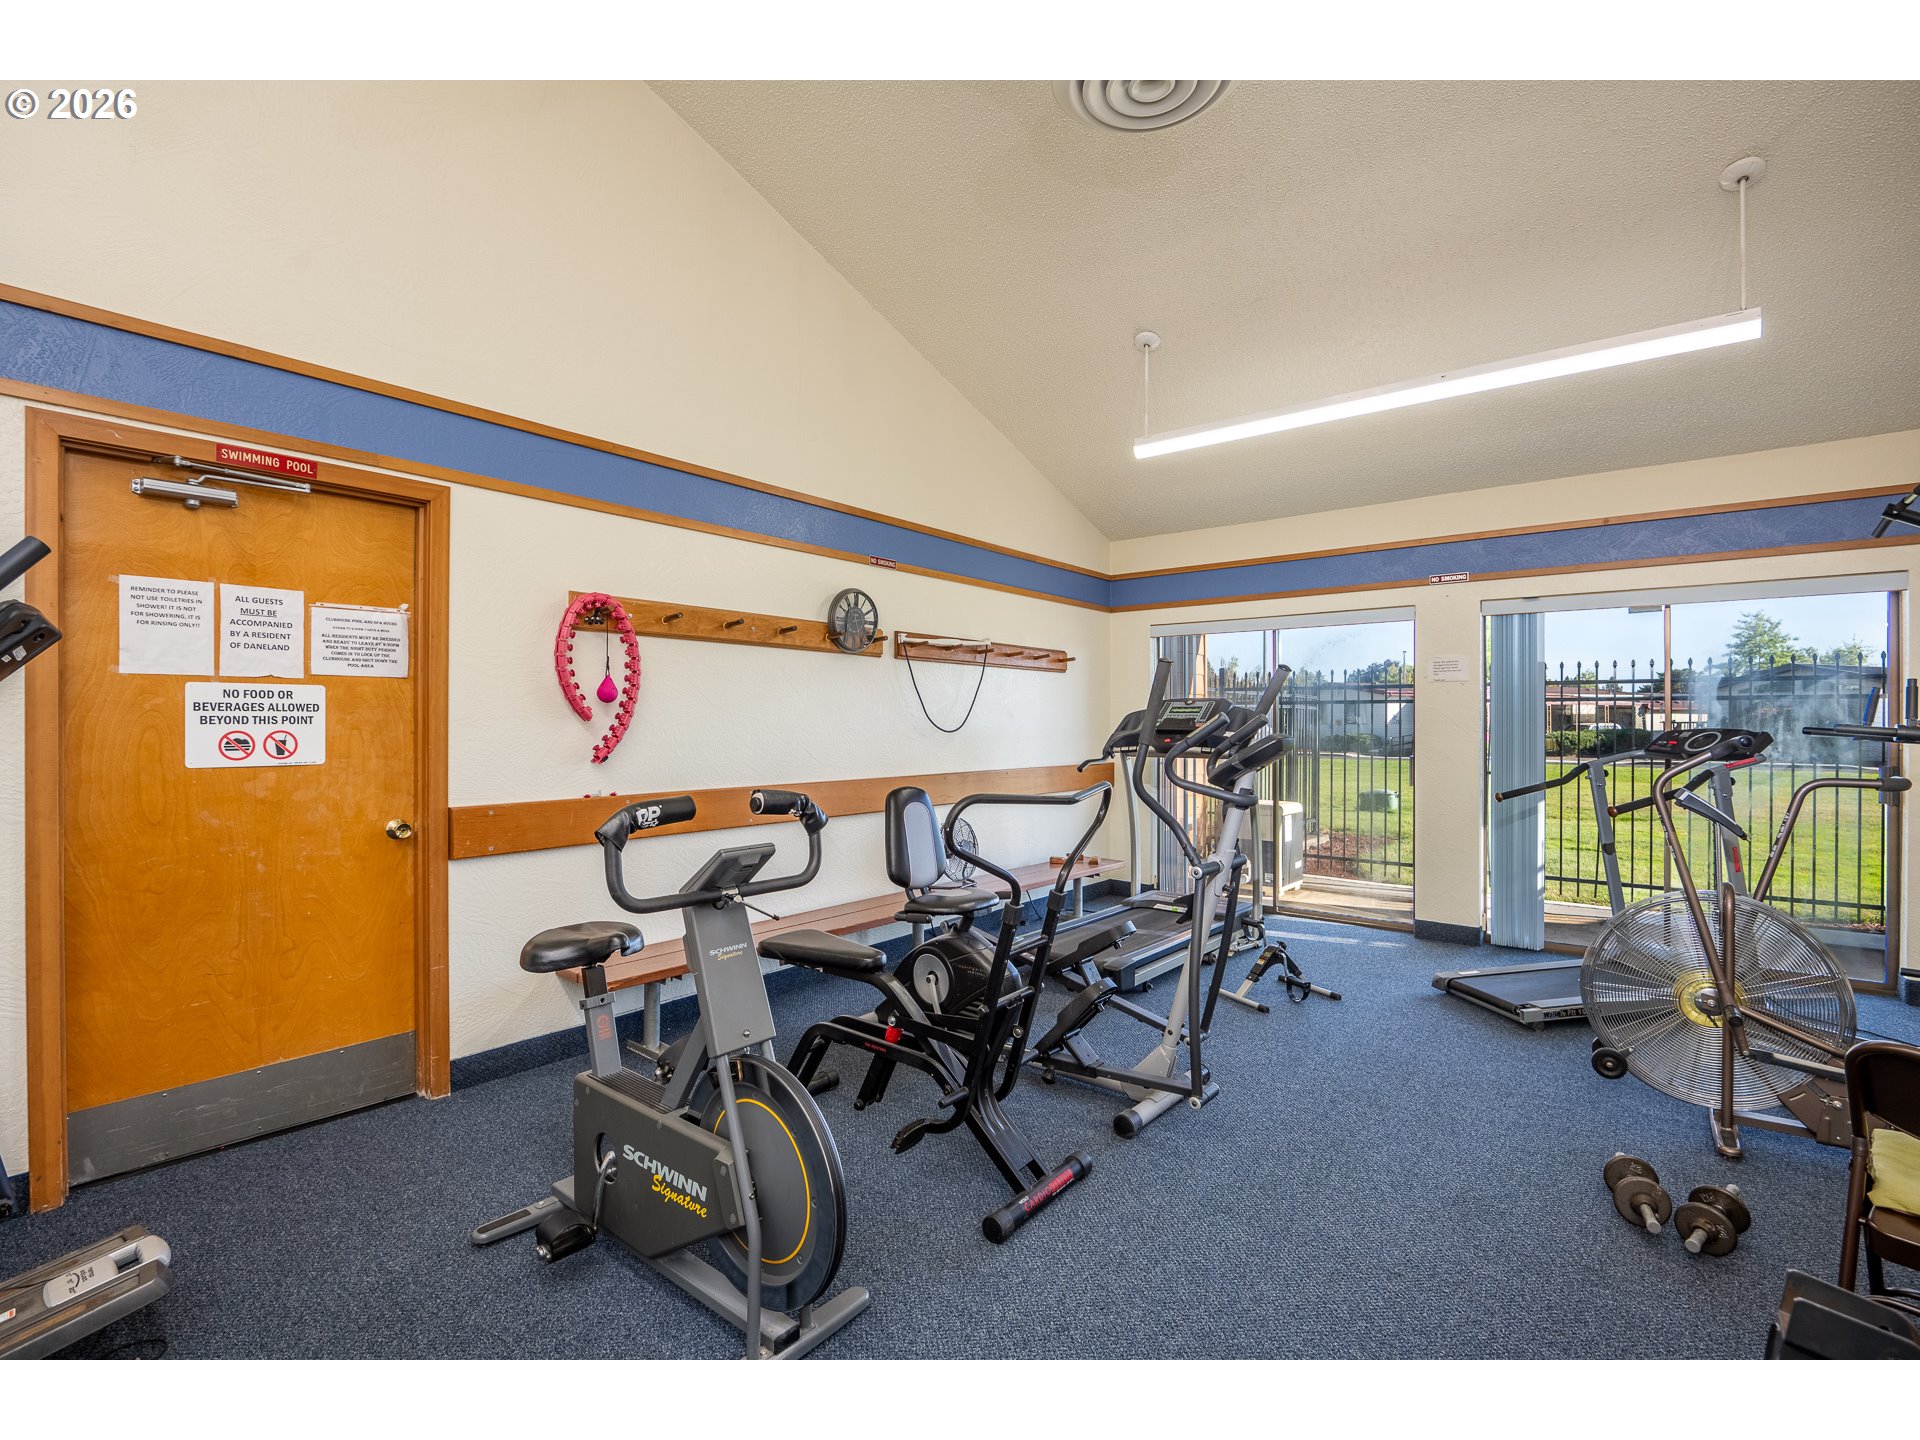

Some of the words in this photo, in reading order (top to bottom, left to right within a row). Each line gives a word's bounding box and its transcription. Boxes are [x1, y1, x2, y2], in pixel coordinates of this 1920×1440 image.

[221, 448, 280, 467] SWIMMING
[286, 460, 313, 475] POOL
[878, 559, 896, 567] SMOKING
[252, 597, 283, 605] GUESTS
[230, 619, 293, 628] ACCOMPANIED
[244, 643, 290, 651] DANELAND
[223, 689, 240, 698] NO
[243, 690, 274, 699] FOOD
[278, 690, 293, 699] OR
[193, 702, 264, 712] BEVERAGES
[268, 703, 319, 712] ALLOWED
[200, 716, 249, 724] BEYOND
[252, 716, 278, 724] THIS
[282, 716, 314, 724] POINT
[710, 942, 747, 956] SCHWINN
[623, 1144, 707, 1202] SCHWINN
[651, 1174, 707, 1218] Signature
